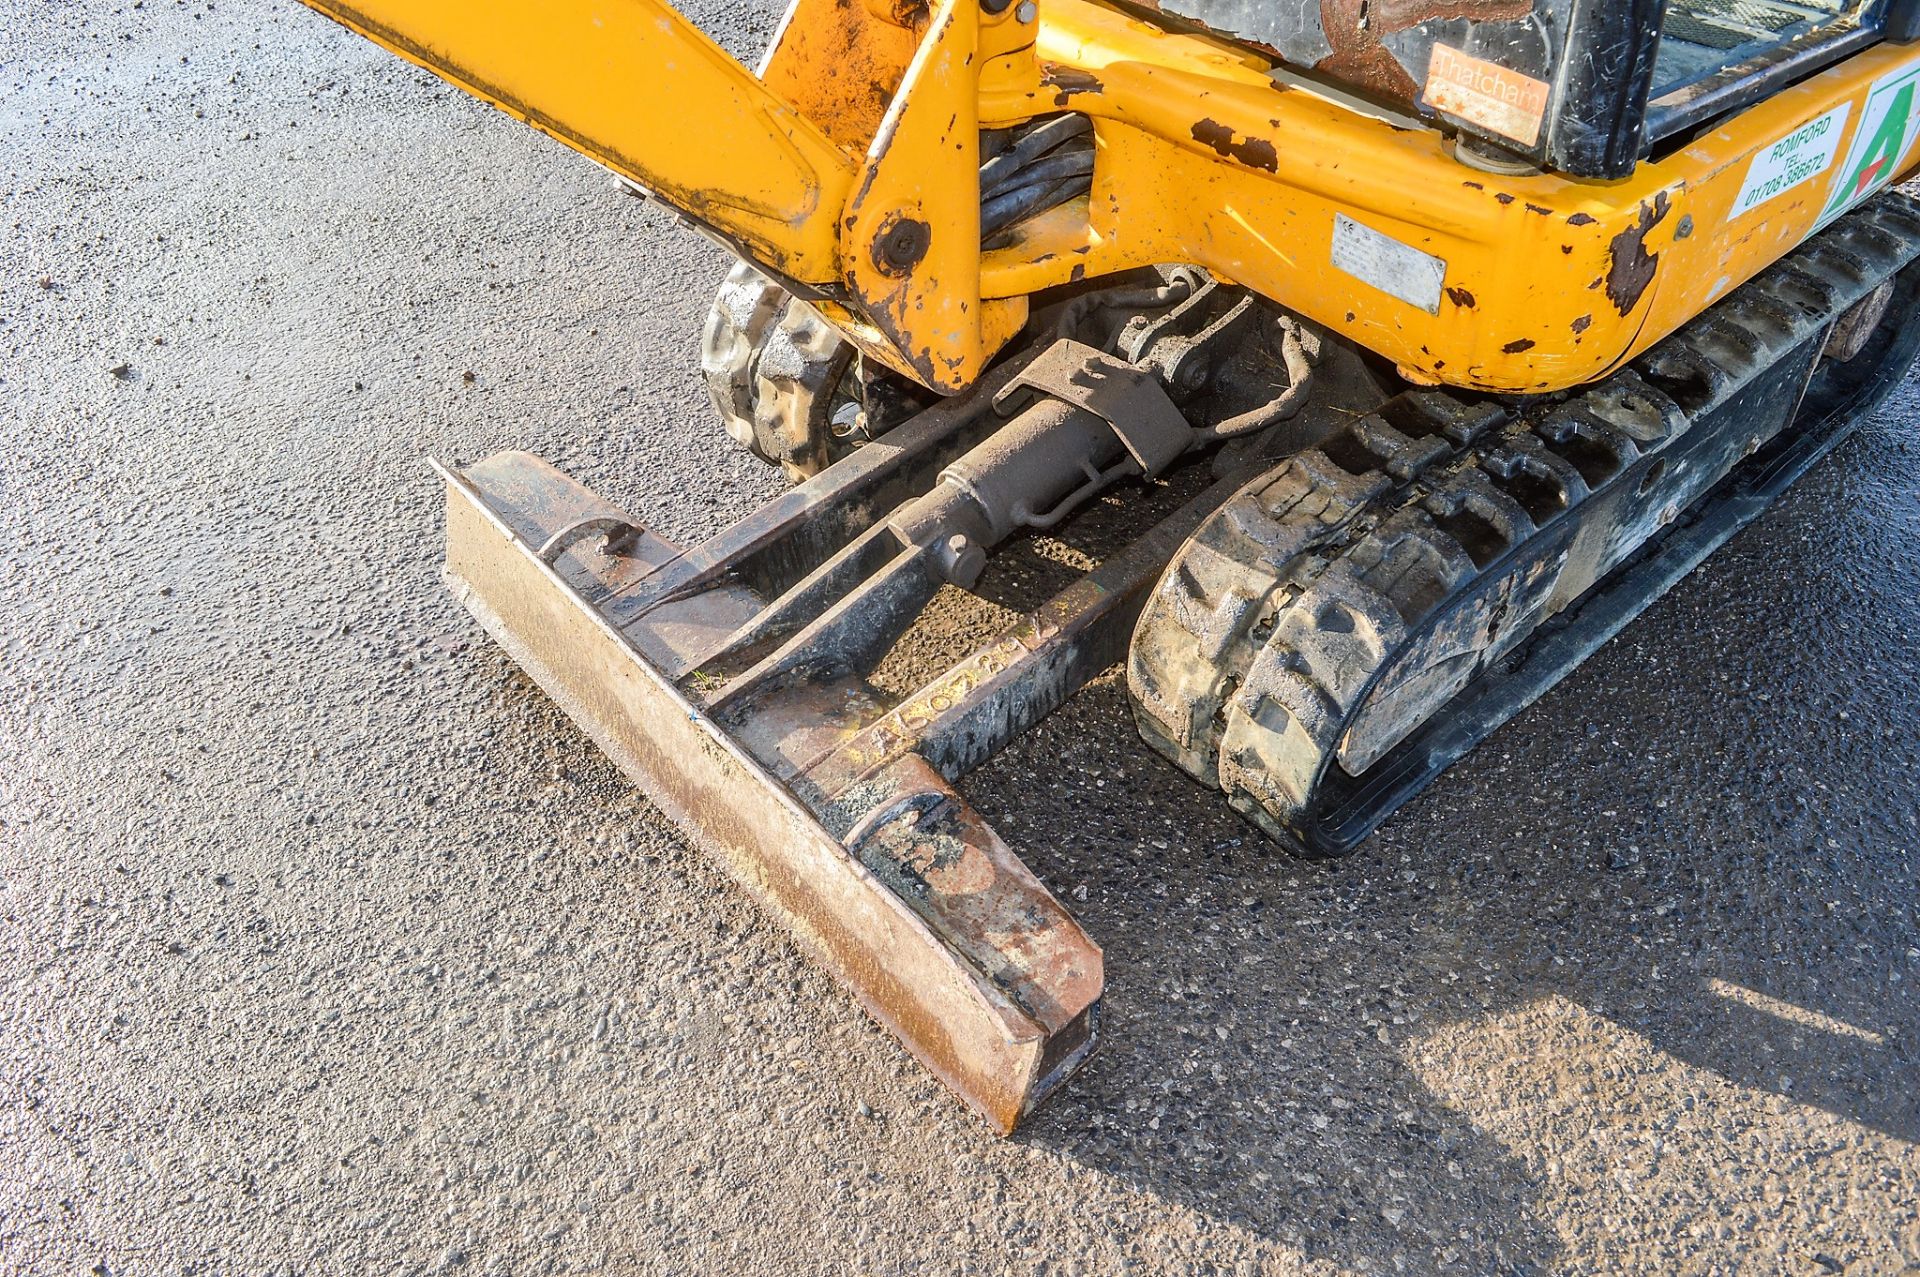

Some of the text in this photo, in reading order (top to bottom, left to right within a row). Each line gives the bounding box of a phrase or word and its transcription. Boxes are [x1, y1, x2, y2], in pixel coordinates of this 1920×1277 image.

[1436, 49, 1541, 115] Thatcham
[1769, 116, 1832, 163] ROMFORD
[1745, 152, 1826, 207] 01708 386672
